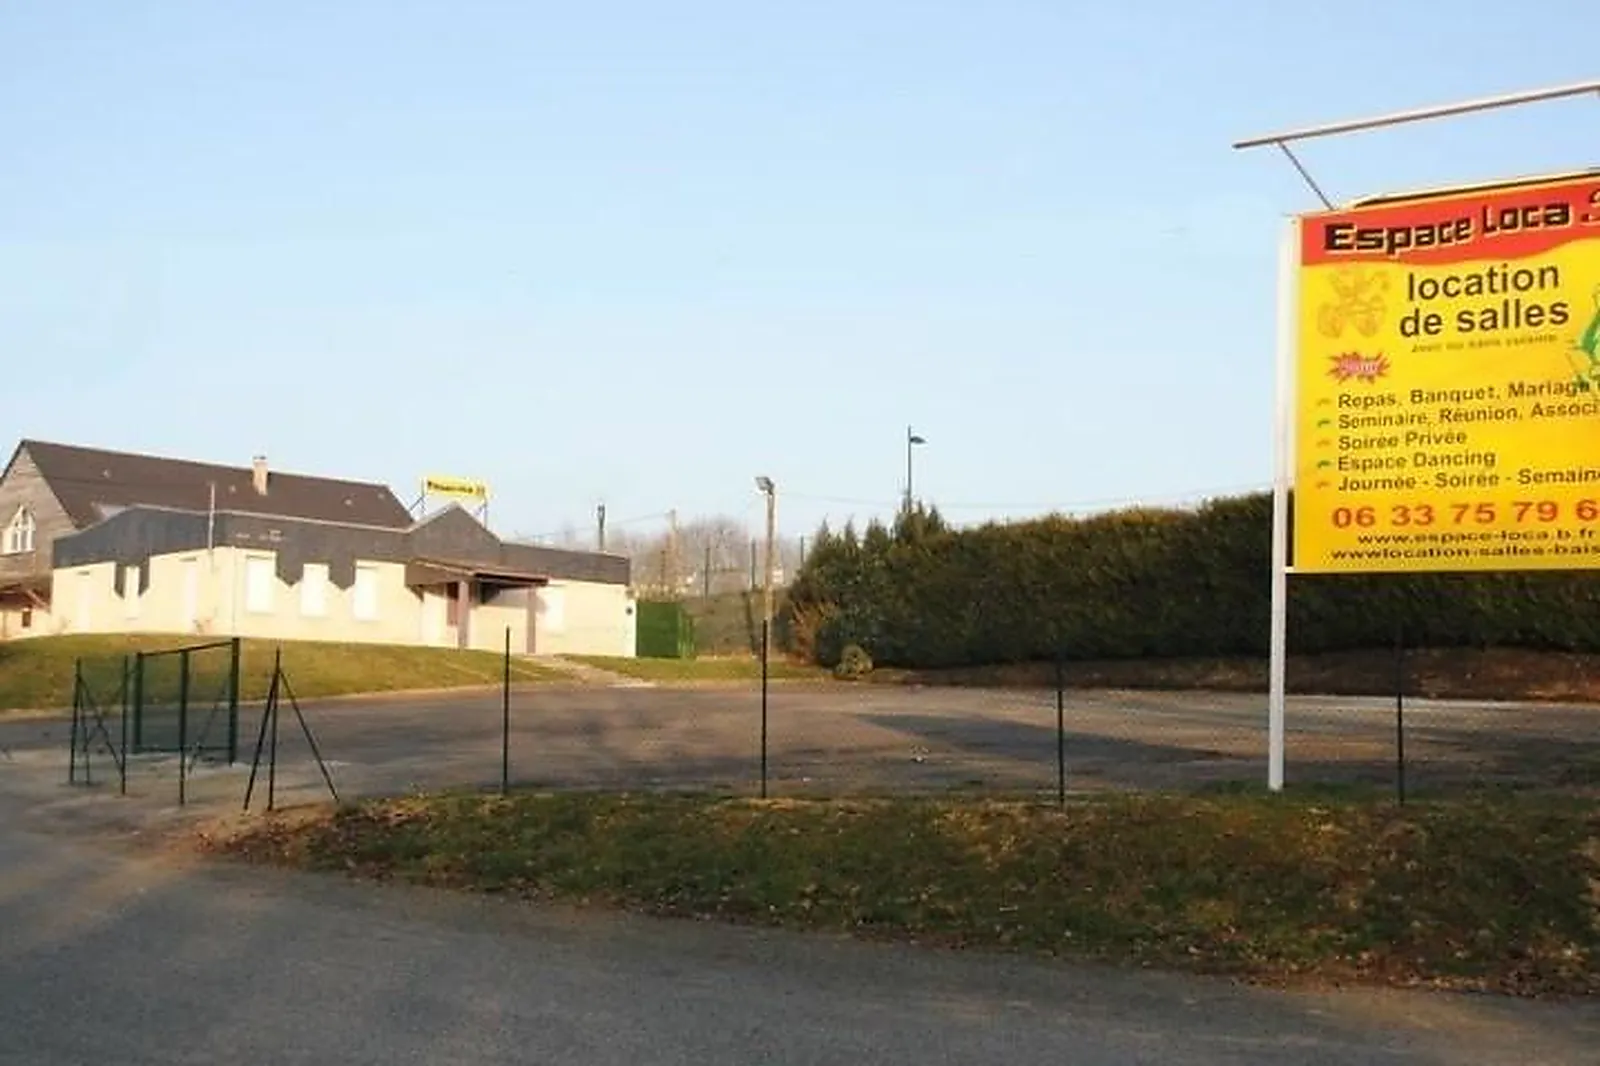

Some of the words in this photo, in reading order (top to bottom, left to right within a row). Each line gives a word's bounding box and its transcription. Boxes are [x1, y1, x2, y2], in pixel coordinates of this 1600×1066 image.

[1324, 216, 1473, 256] Espace
[1481, 202, 1572, 237] Loca
[1408, 263, 1560, 301] location
[1400, 308, 1443, 338] de
[1456, 299, 1570, 334] salles
[1338, 456, 1406, 474] Espace
[1413, 450, 1496, 469] Dancing
[1516, 467, 1600, 485] Semain
[1333, 506, 1377, 530] 06
[1390, 504, 1435, 527] 33
[1450, 503, 1497, 525] 75
[1512, 501, 1560, 523] 79
